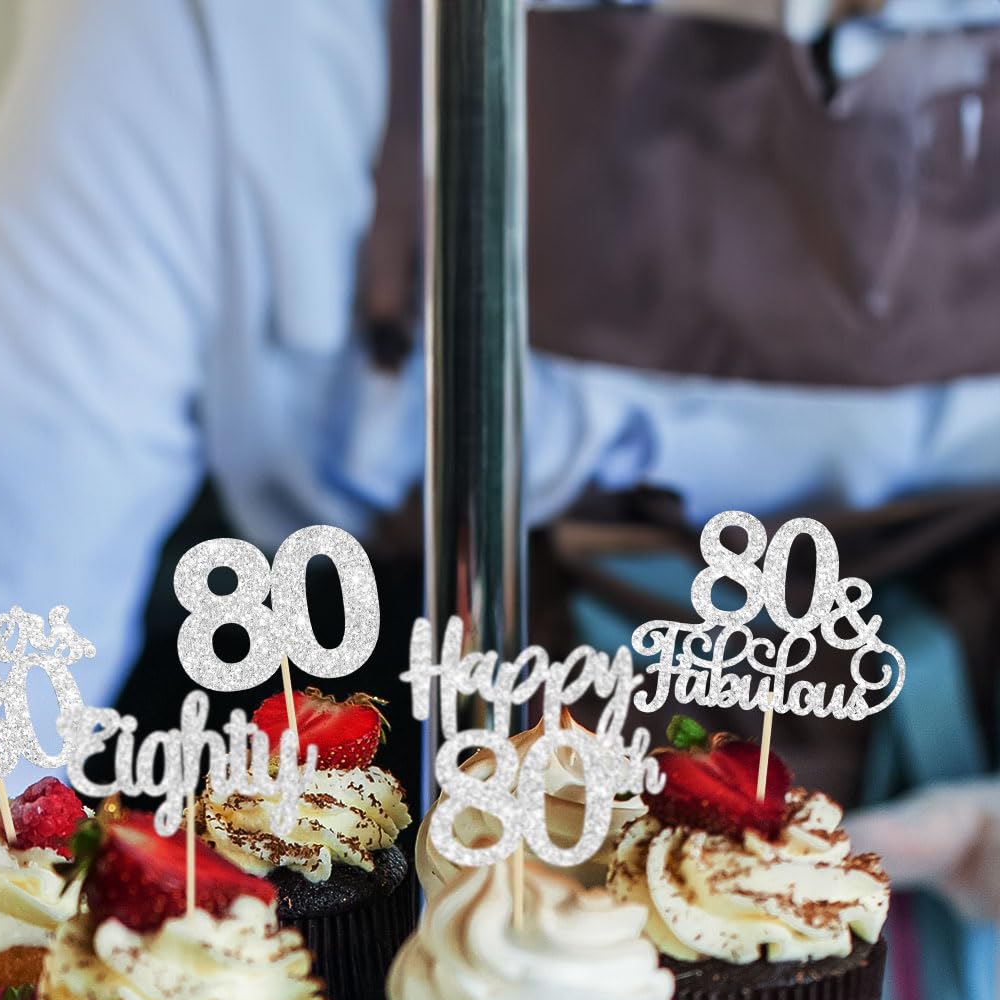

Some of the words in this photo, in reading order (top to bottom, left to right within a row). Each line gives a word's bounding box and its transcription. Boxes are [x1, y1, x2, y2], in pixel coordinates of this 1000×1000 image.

[173, 524, 381, 692] 80
[631, 619, 907, 721] Fabulous
[400, 615, 644, 741] Happy
[56, 690, 318, 837] Eighty
